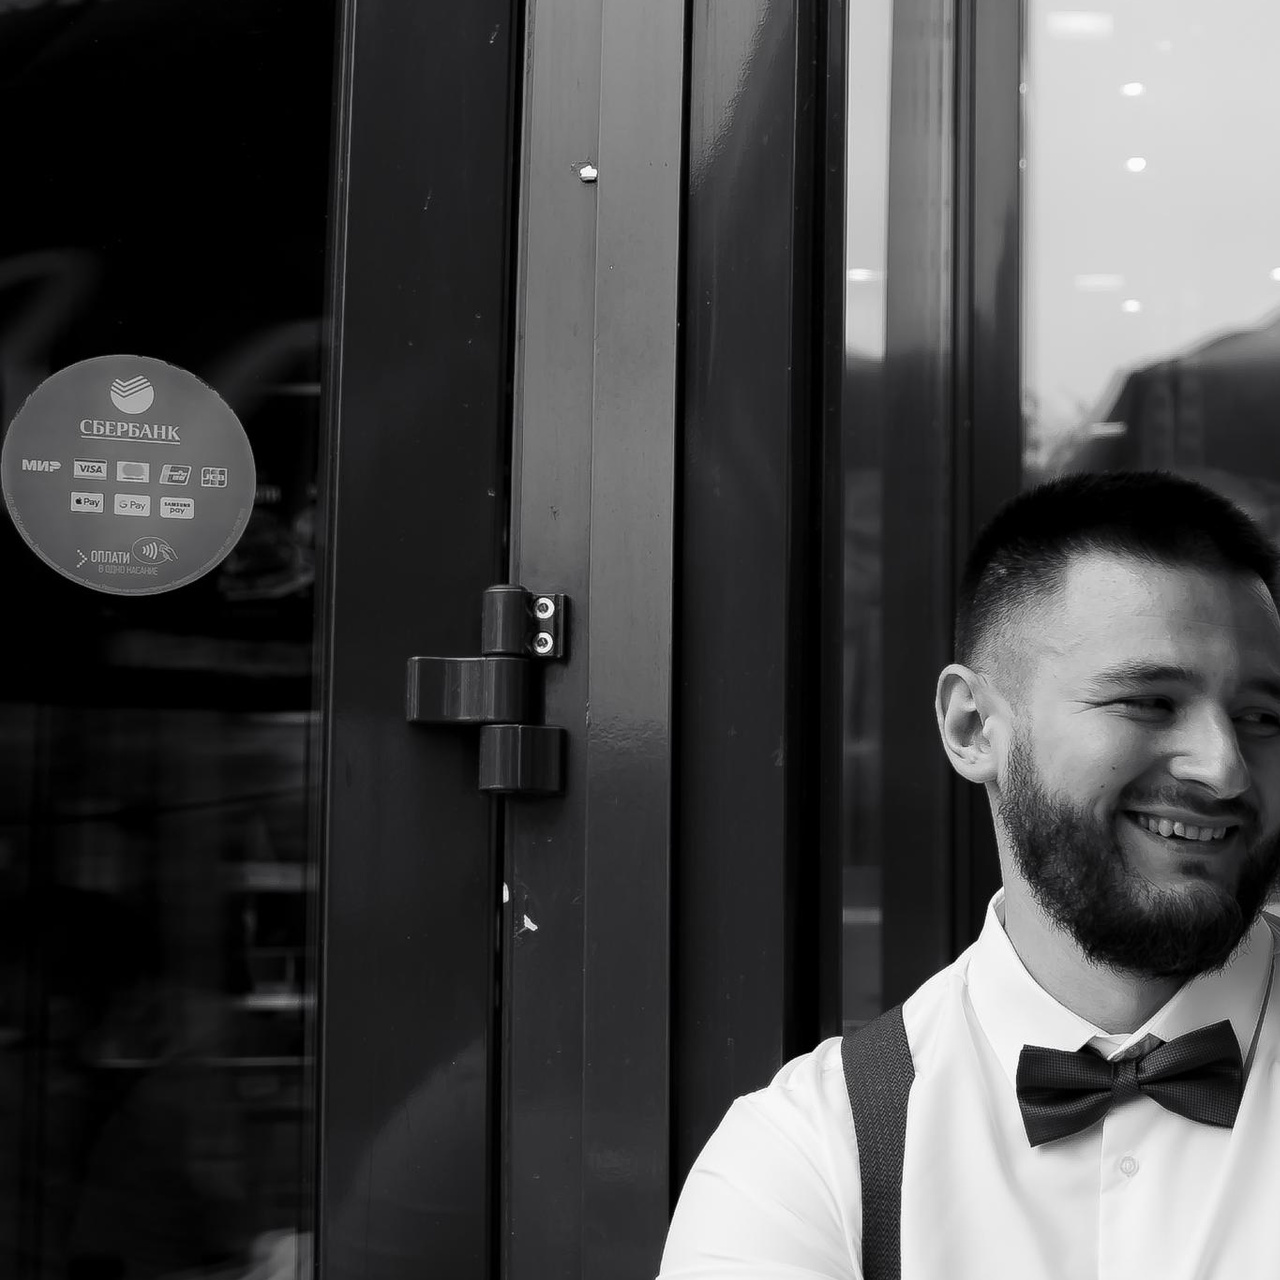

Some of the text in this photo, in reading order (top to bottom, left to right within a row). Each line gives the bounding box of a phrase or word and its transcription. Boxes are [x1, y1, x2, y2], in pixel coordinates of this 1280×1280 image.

[80, 419, 181, 441] СБЕРБАНК
[22, 459, 62, 472] МИР
[79, 464, 103, 474] VISA
[83, 497, 101, 508] Pay
[130, 501, 146, 511] Pay
[90, 550, 130, 564] ОПЛАТИ
